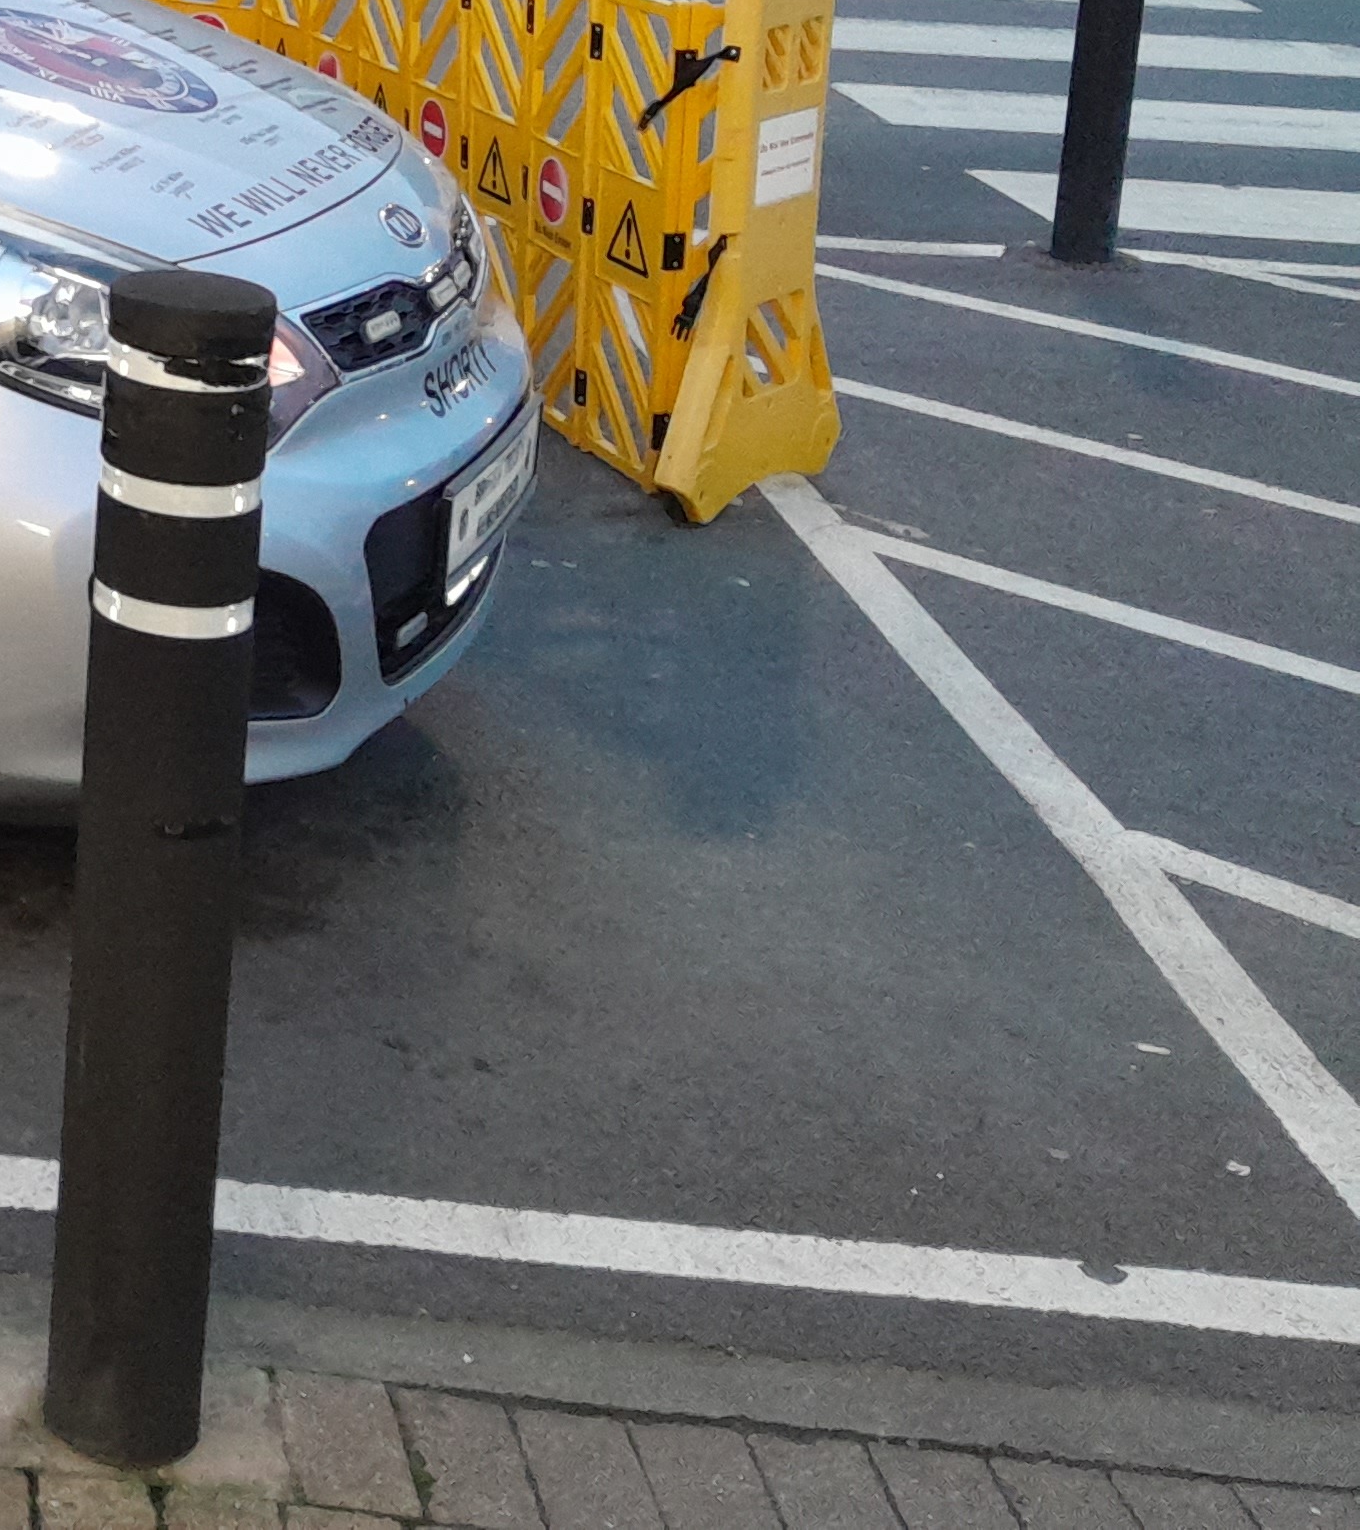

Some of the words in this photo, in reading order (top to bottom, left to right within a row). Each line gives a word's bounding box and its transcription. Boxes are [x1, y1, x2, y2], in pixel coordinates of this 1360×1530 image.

[186, 202, 253, 239] WE
[231, 176, 308, 216] WILL
[286, 144, 362, 188] NEVER
